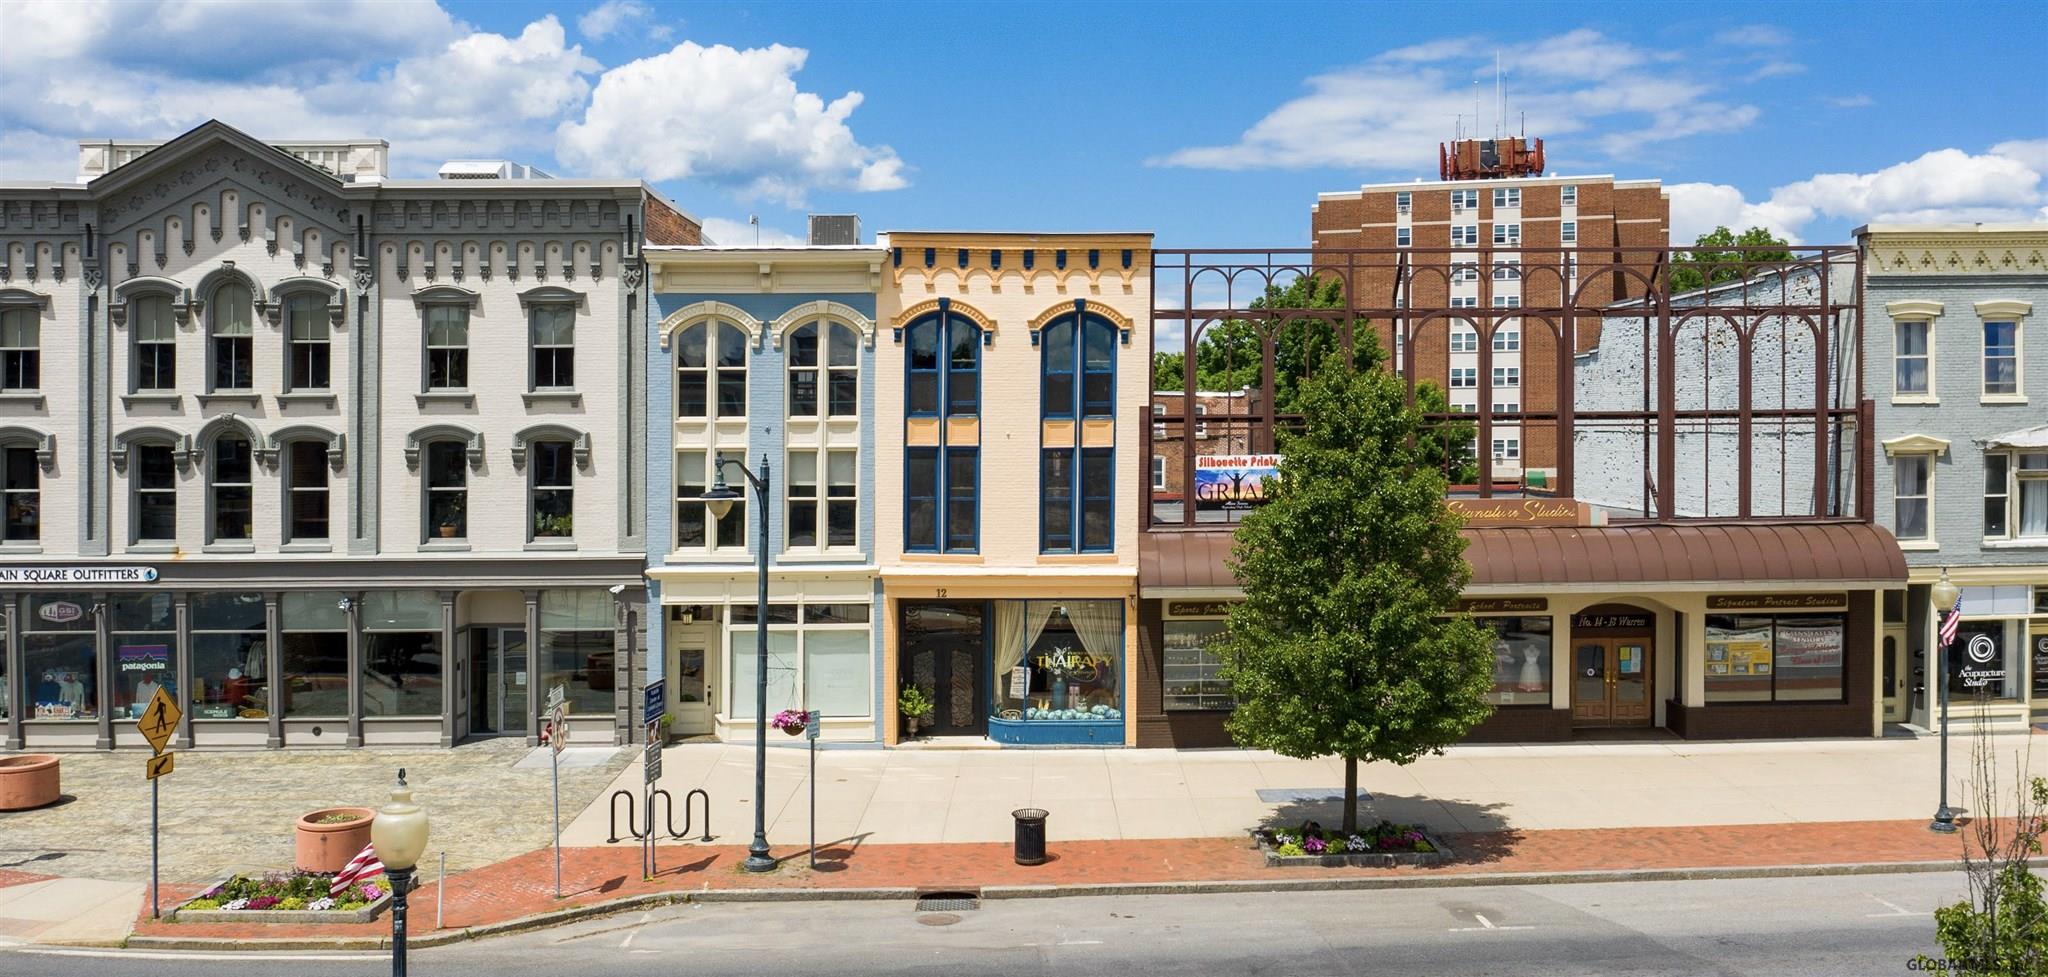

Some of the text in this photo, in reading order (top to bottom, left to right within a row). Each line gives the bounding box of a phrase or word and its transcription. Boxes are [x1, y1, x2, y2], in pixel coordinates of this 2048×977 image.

[1199, 455, 1278, 467] Silhouette Prints
[1523, 499, 1576, 521] Studios
[23, 568, 67, 582] SQUARE
[73, 568, 139, 580] OUTFITTERS
[936, 588, 947, 598] 12
[1503, 600, 1541, 609] Portraits
[1716, 595, 1838, 608] Signature Portrait Studios
[1173, 604, 1200, 615] Sports
[122, 661, 166, 672] patagonia
[1958, 669, 2007, 680] Acupuncture
[1963, 677, 1989, 687] Studio
